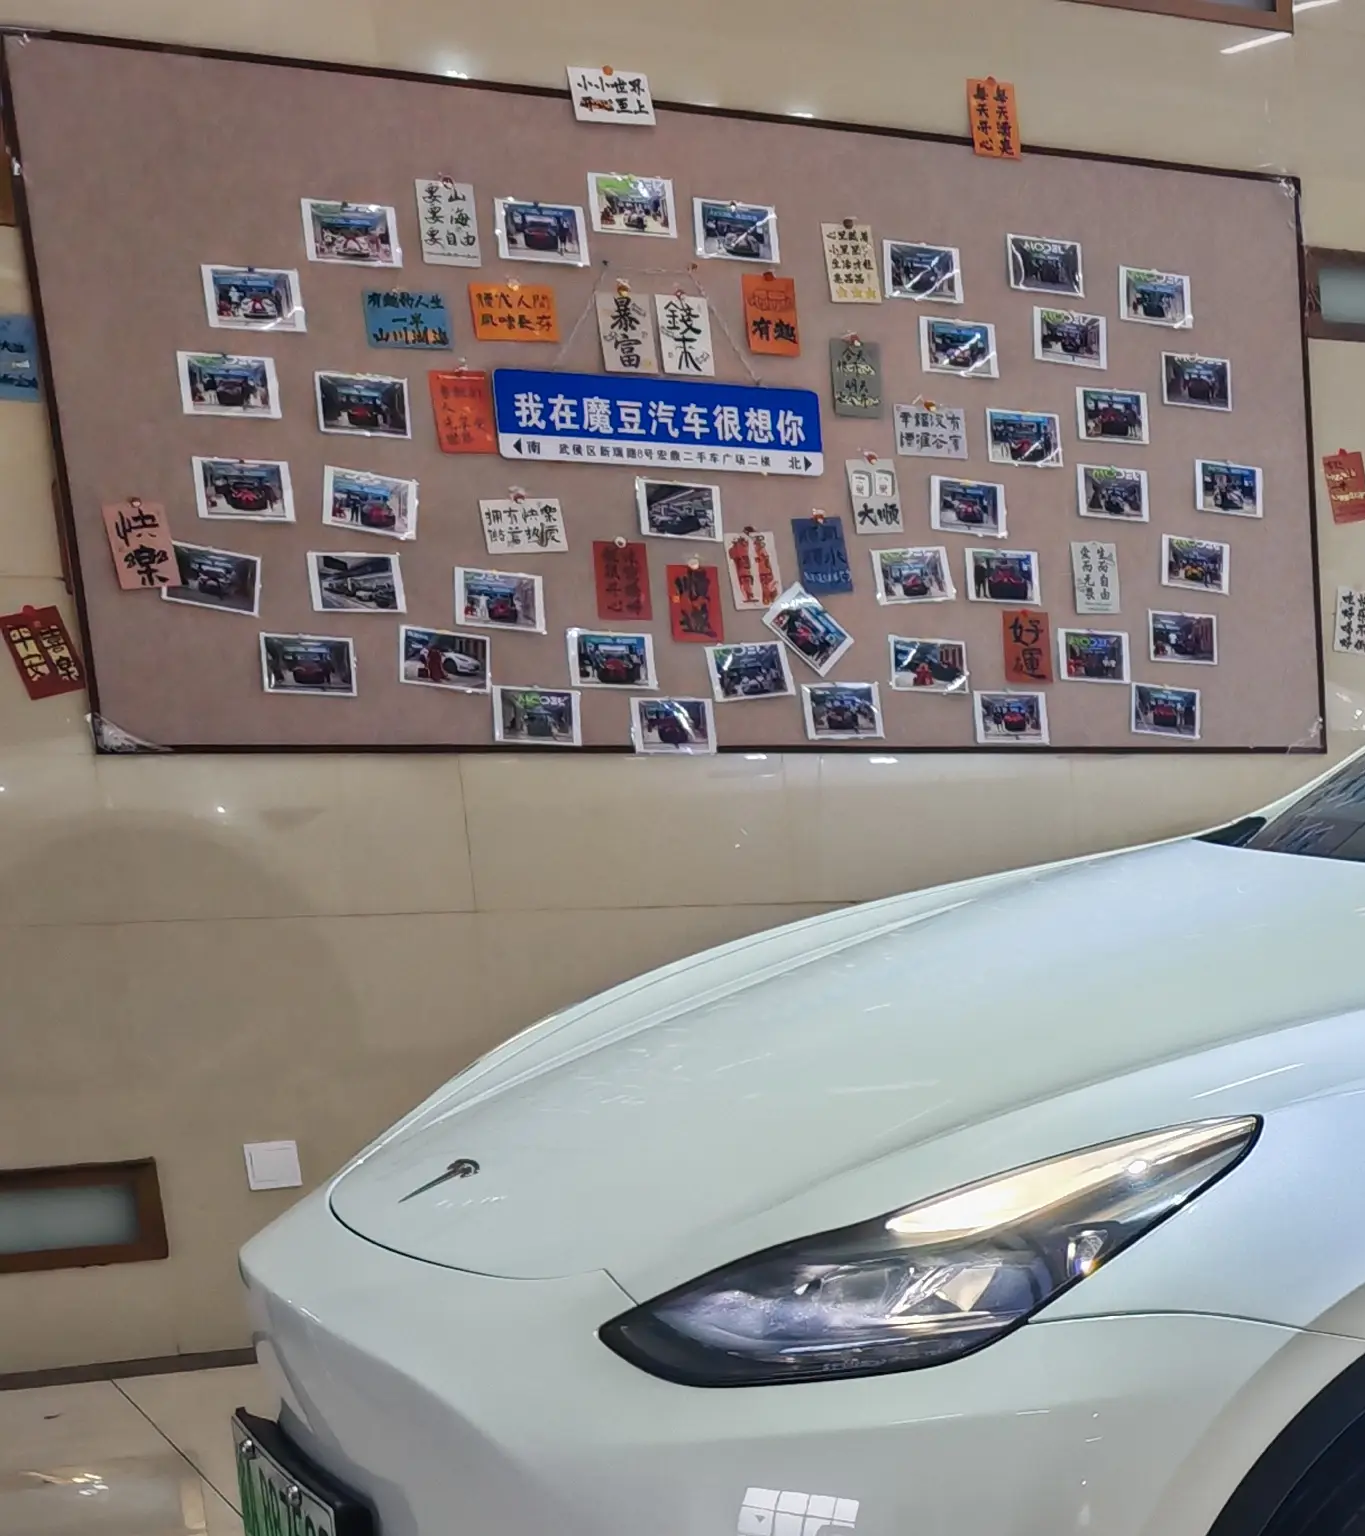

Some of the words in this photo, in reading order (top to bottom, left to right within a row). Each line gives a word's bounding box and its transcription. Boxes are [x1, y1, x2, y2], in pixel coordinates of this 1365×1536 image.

[514, 391, 806, 447] 我在魔豆汽车很想你
[789, 456, 802, 470] 北
[857, 502, 900, 526] 大顺
